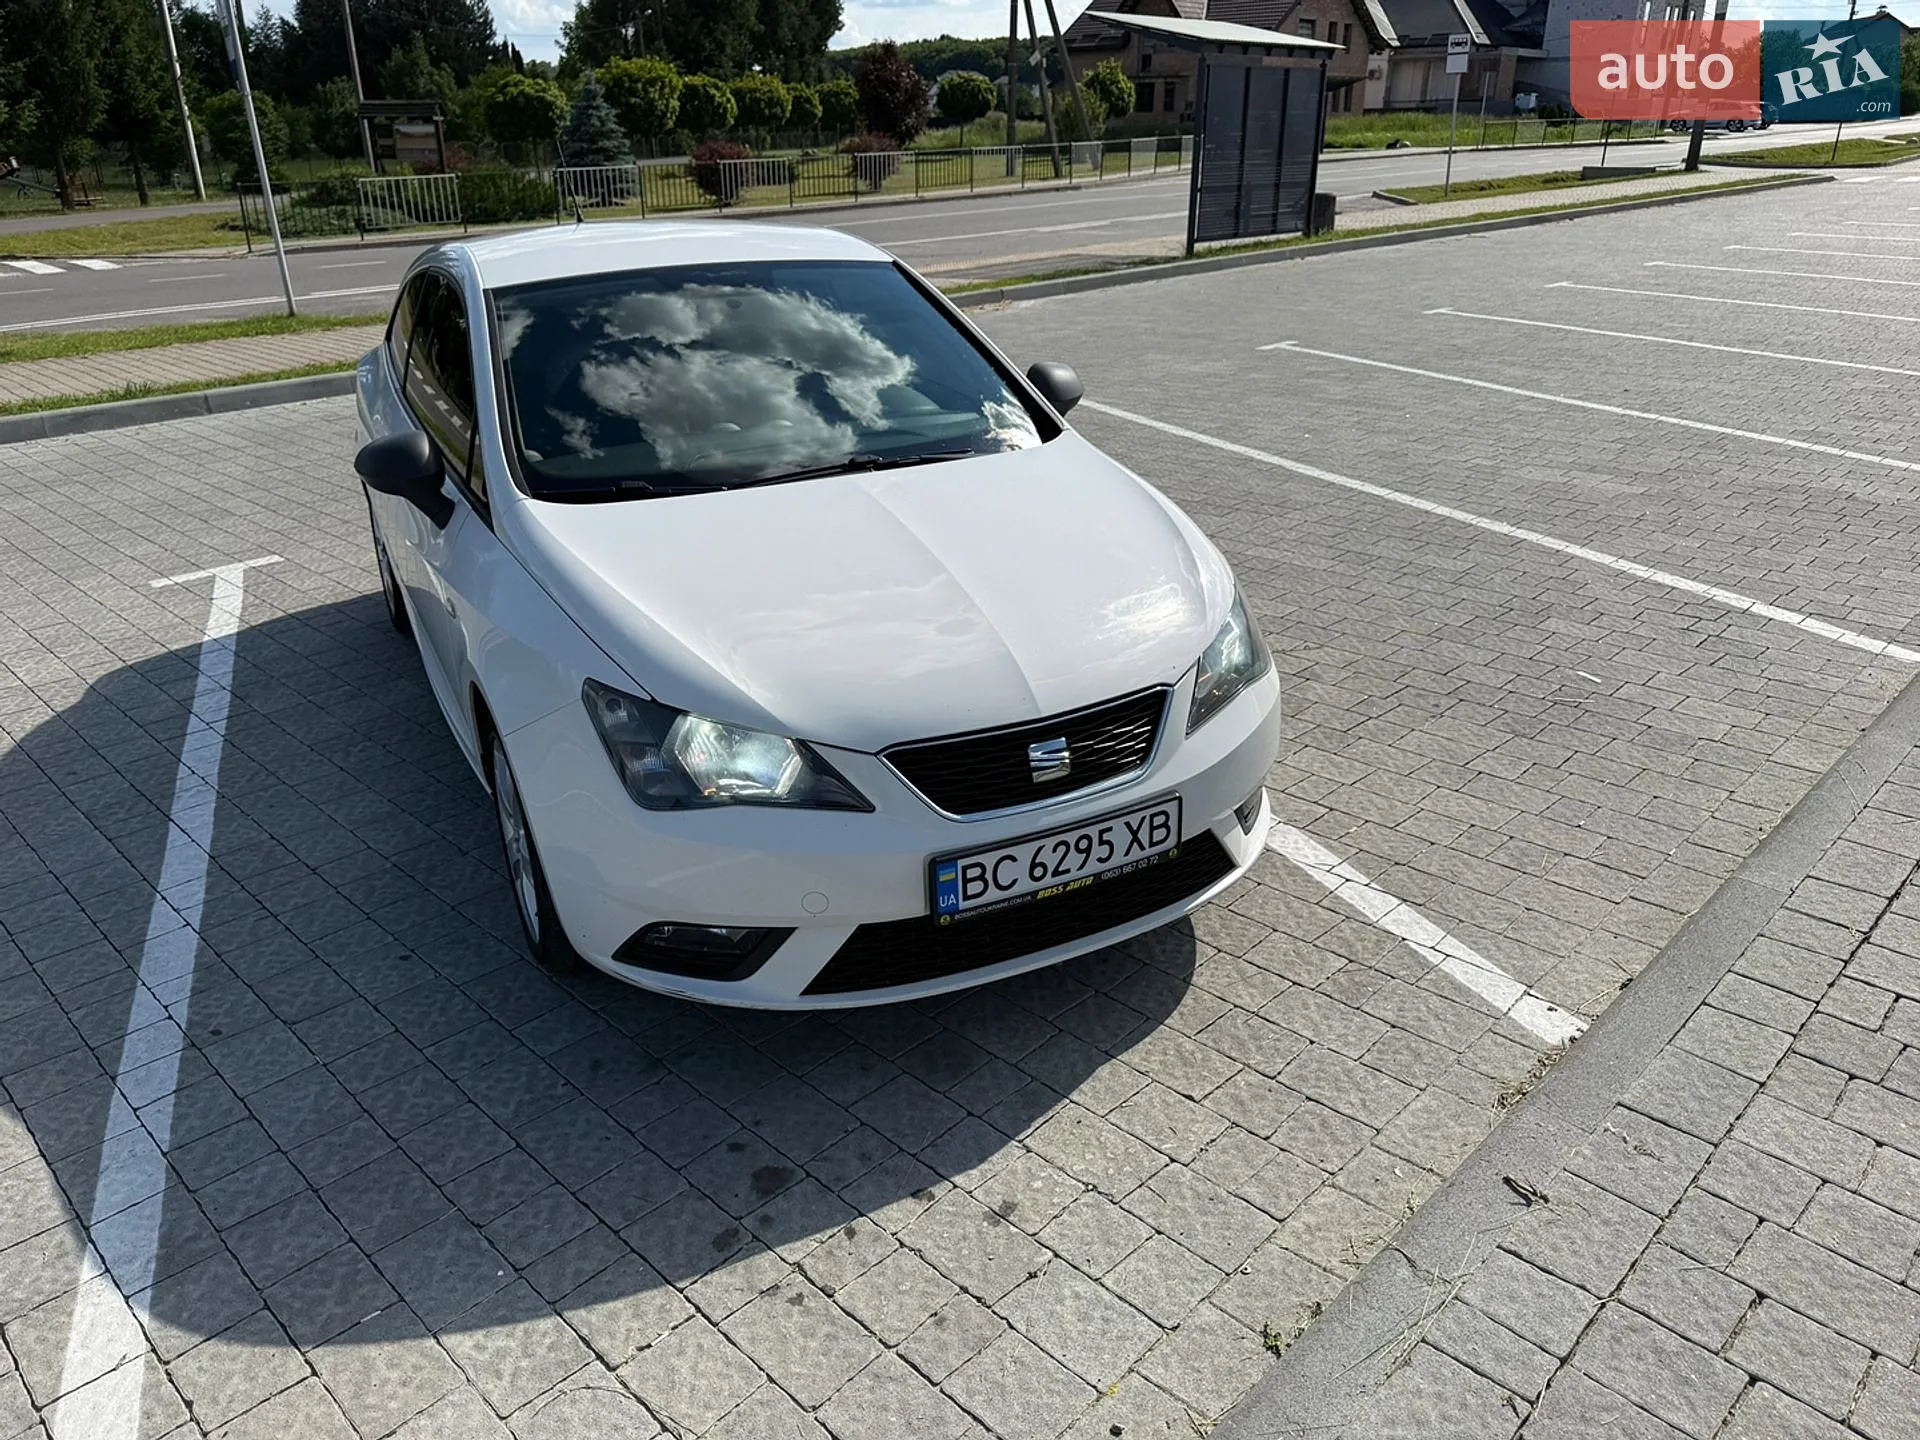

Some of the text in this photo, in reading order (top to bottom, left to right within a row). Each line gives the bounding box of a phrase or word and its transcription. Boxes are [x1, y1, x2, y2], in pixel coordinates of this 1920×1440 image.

[962, 810, 1171, 901] BC 6295 XB
[1036, 876, 1095, 900] BOSS AUTO
[939, 893, 957, 908] UA
